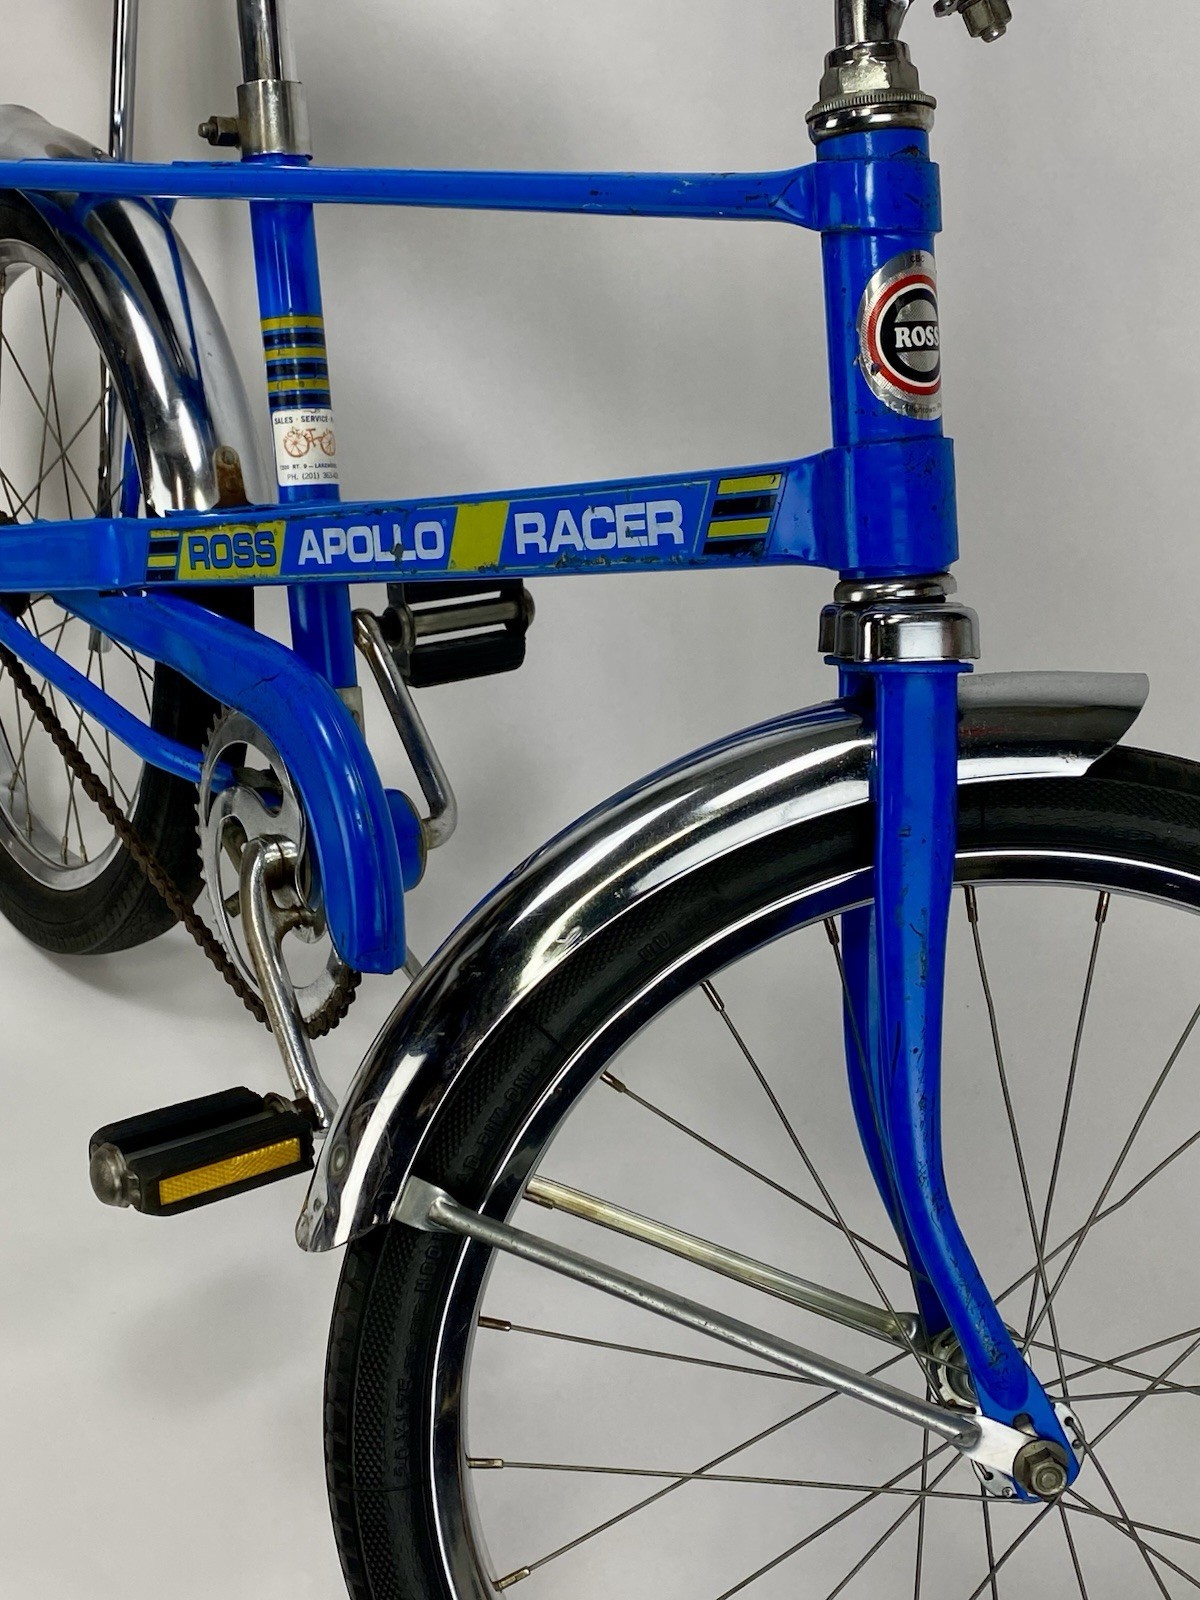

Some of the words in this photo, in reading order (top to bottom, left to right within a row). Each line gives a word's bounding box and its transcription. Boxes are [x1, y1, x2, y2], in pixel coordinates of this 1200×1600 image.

[274, 416, 294, 425] SALES
[301, 471, 320, 480] (201)
[187, 530, 278, 571] ROSS
[298, 521, 445, 566] APOLLO
[514, 499, 685, 555] RACER
